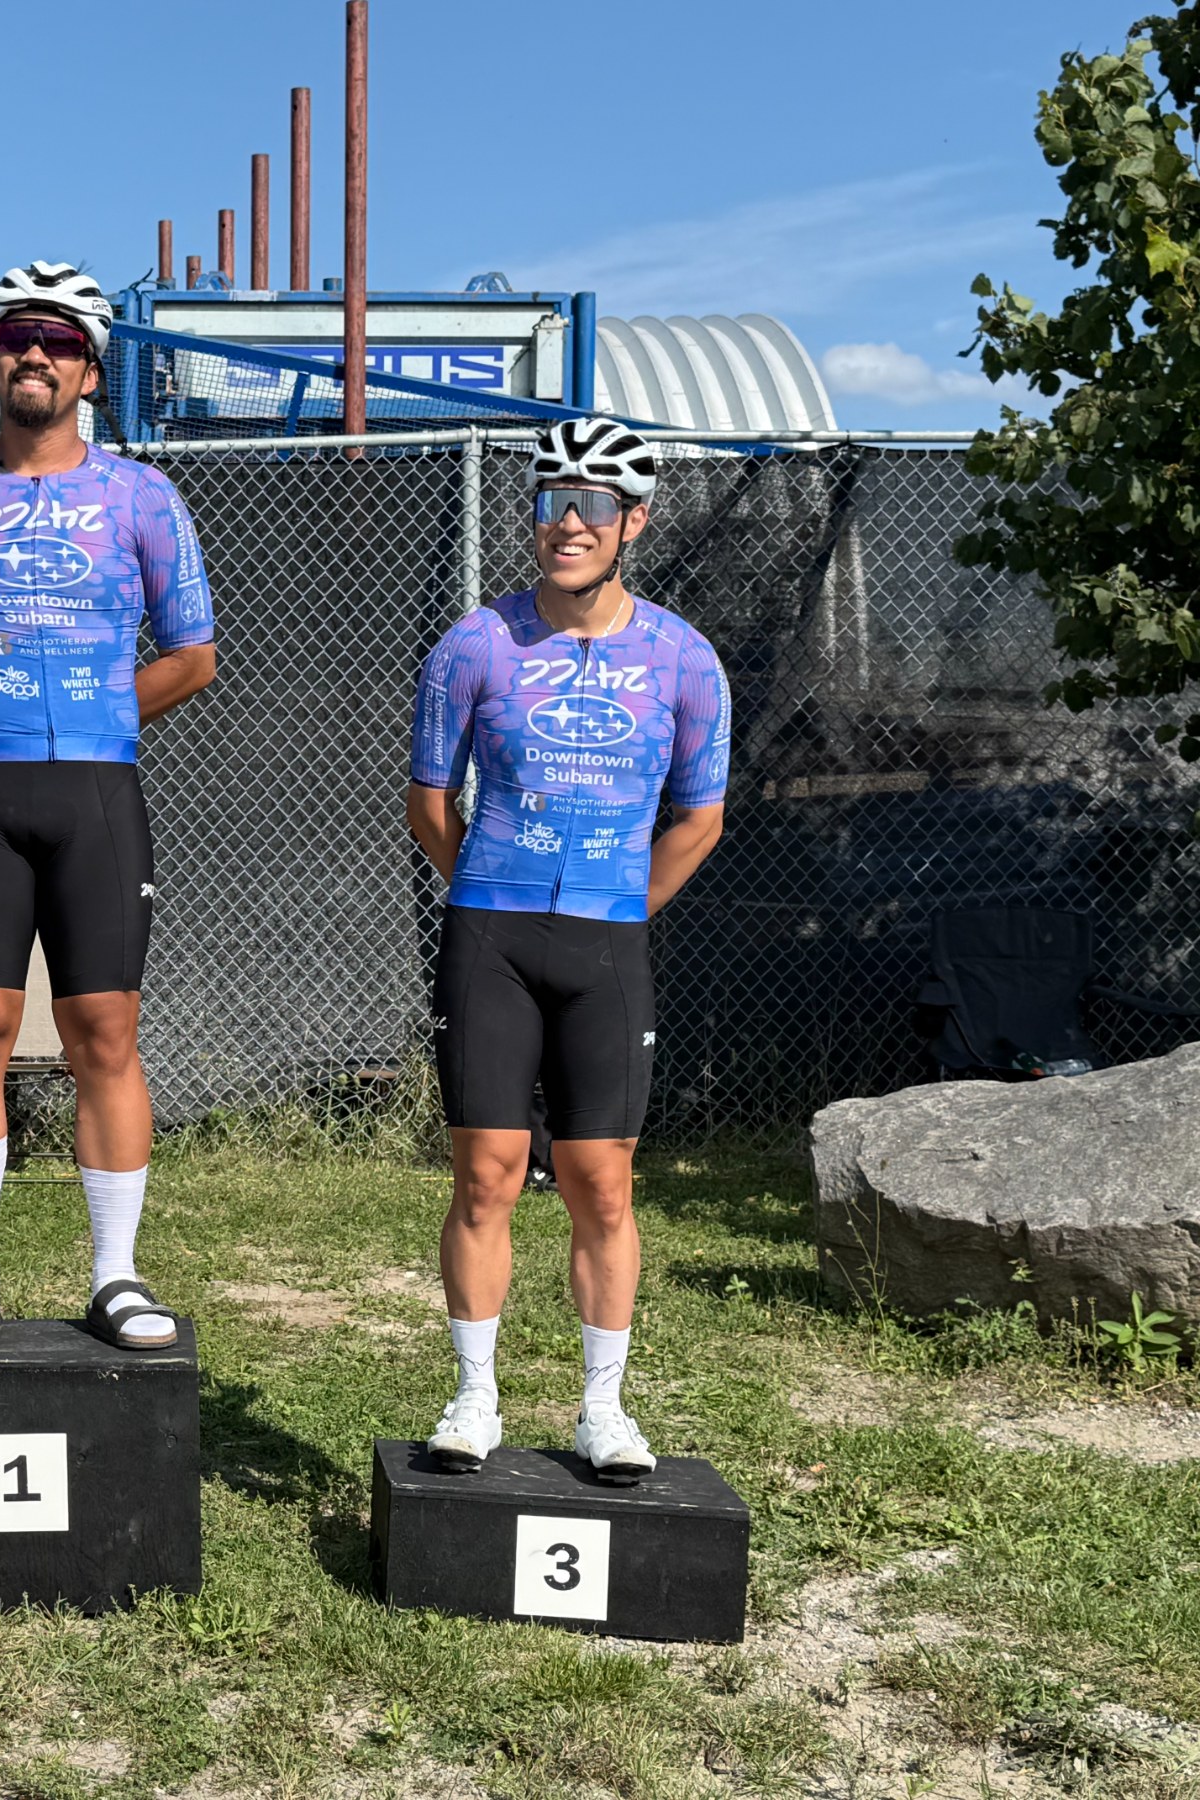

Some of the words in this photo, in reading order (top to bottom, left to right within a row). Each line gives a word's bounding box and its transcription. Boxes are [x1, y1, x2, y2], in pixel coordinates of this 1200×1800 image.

[170, 498, 188, 581] Downtown
[3, 610, 76, 627] Subaru
[17, 637, 99, 646] PHYSIOTHERAPY
[19, 647, 40, 656] AND
[44, 647, 94, 656] WELLNESS
[69, 666, 92, 678] TWO
[71, 690, 95, 701] CAFE
[525, 747, 634, 769] Downtown
[543, 766, 614, 786] Subaru
[551, 805, 572, 814] AND
[574, 807, 623, 817] WELLNESS
[514, 834, 562, 854] depot
[586, 849, 610, 860] CAFE
[3, 1455, 41, 1502] 1
[543, 1542, 581, 1591] 3
